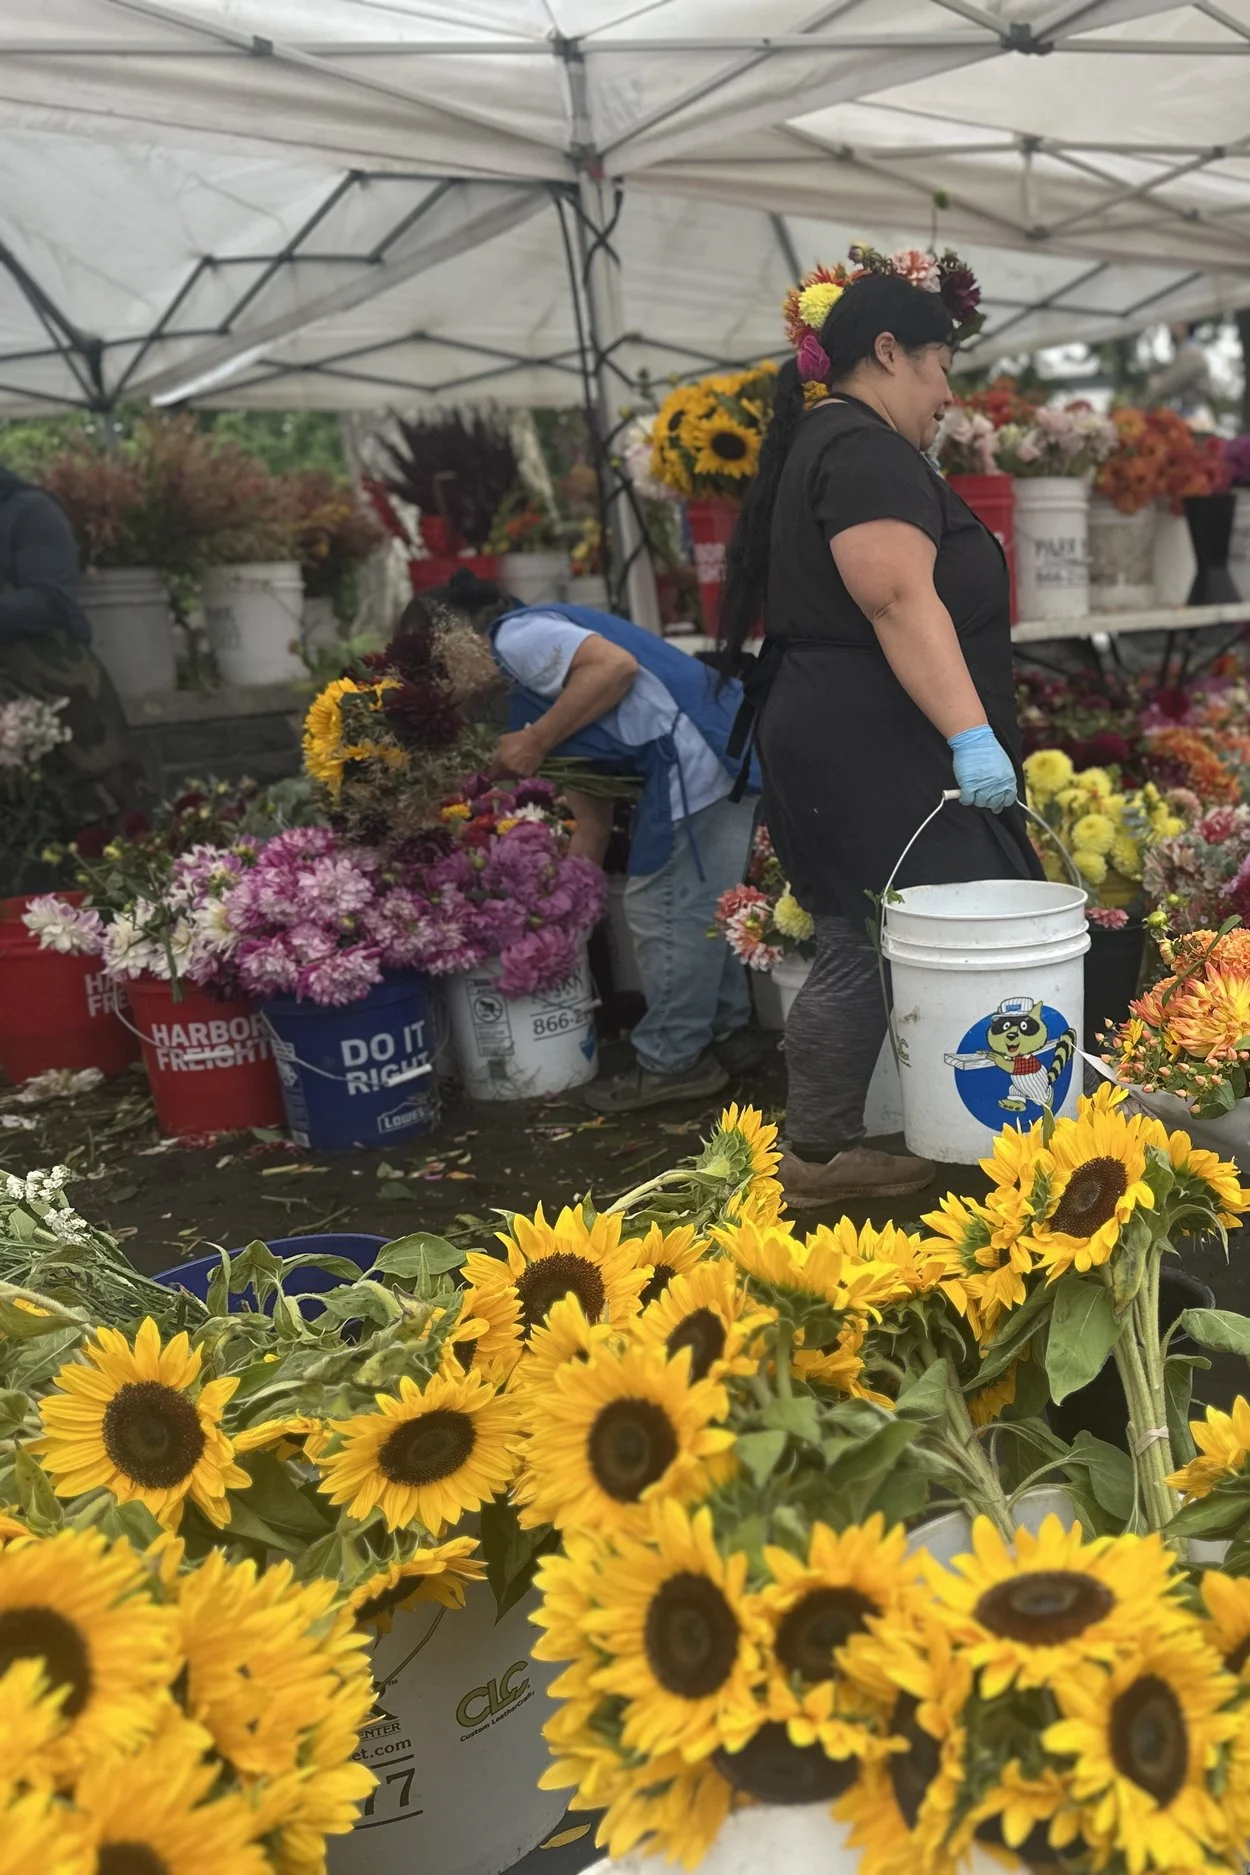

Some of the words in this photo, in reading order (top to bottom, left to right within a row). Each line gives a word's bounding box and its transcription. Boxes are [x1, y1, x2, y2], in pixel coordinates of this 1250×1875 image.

[152, 1014, 271, 1047] HARBOR
[341, 1033, 395, 1067] DO
[404, 1020, 425, 1053] IT
[456, 1661, 529, 1727] CLC
[460, 1723, 490, 1742] Custom
